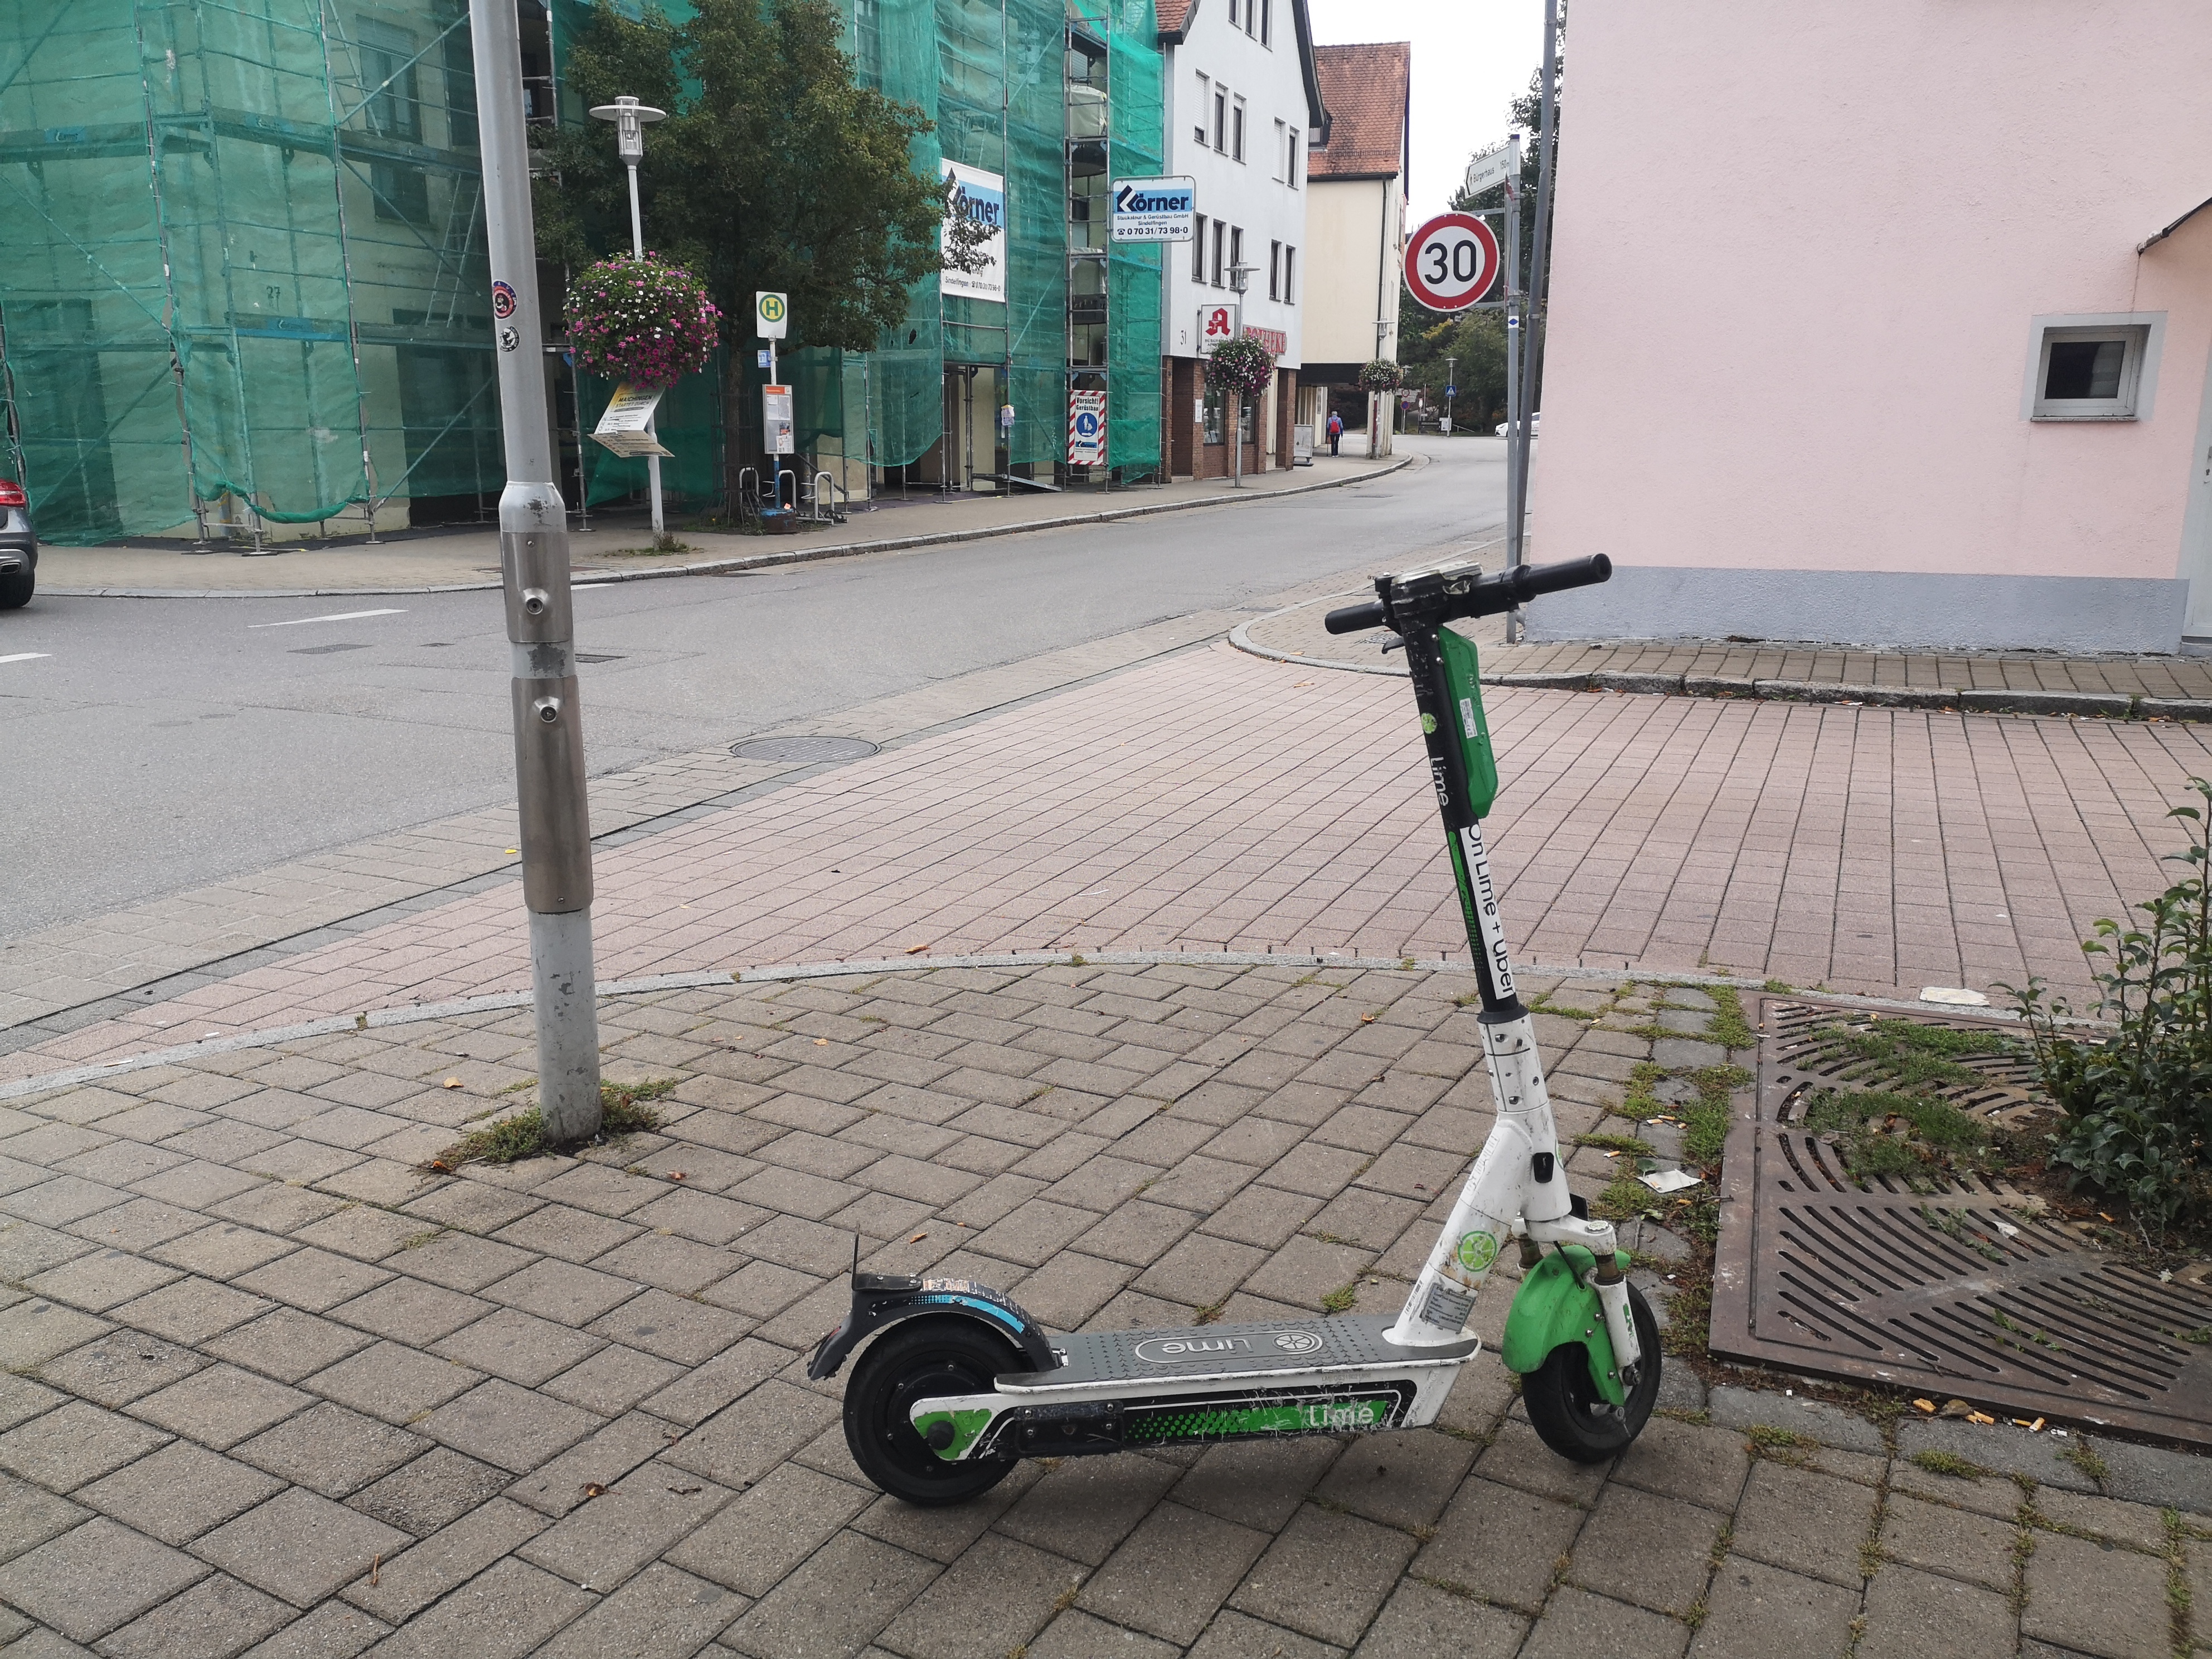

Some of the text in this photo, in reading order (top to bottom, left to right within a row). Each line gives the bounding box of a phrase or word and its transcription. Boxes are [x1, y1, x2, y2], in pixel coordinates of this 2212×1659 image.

[1473, 167, 1495, 182] Bürgerhaus
[1116, 185, 1189, 212] Körner
[1424, 240, 1477, 285] 30
[945, 276, 969, 288] Sindelfingen
[266, 286, 281, 299] 27
[766, 300, 779, 316] H
[1180, 329, 1187, 345] 31
[1243, 326, 1286, 352] POTHEKE
[1430, 757, 1449, 806] Lime
[1476, 860, 1496, 916] Lime
[1162, 1338, 1254, 1354] Lime
[1310, 1404, 1374, 1427] Lime
